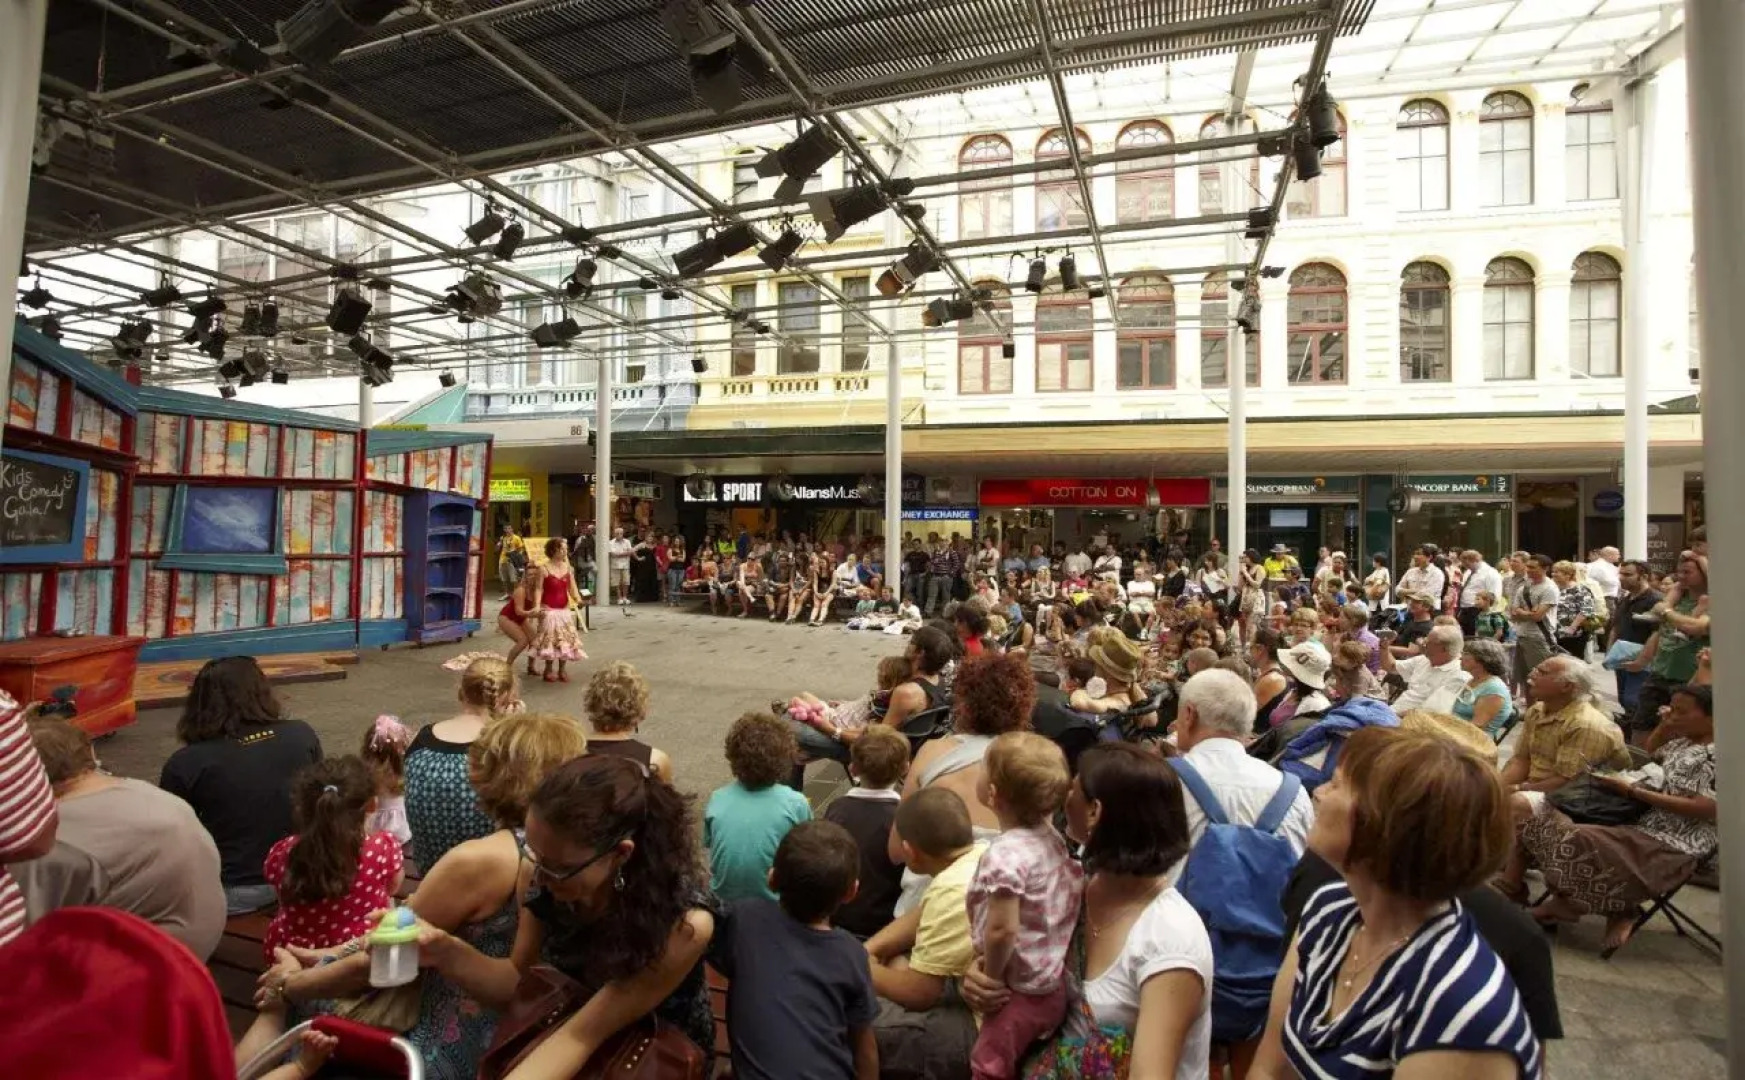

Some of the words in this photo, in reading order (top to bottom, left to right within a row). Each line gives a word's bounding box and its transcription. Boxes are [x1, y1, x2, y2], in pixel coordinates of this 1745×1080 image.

[0, 462, 33, 488] Kids
[723, 482, 762, 502] SPORT
[791, 485, 861, 499] AllansMus
[1049, 486, 1107, 497] COTTON
[1115, 486, 1136, 497] ON
[1246, 484, 1289, 493] SUNCORP
[1291, 484, 1317, 493] BANK
[1404, 483, 1449, 492] NCORP
[1451, 483, 1479, 492] BANK
[18, 484, 65, 510] Comedy
[901, 510, 921, 519] ONEY
[924, 510, 970, 519] EXCHANGE
